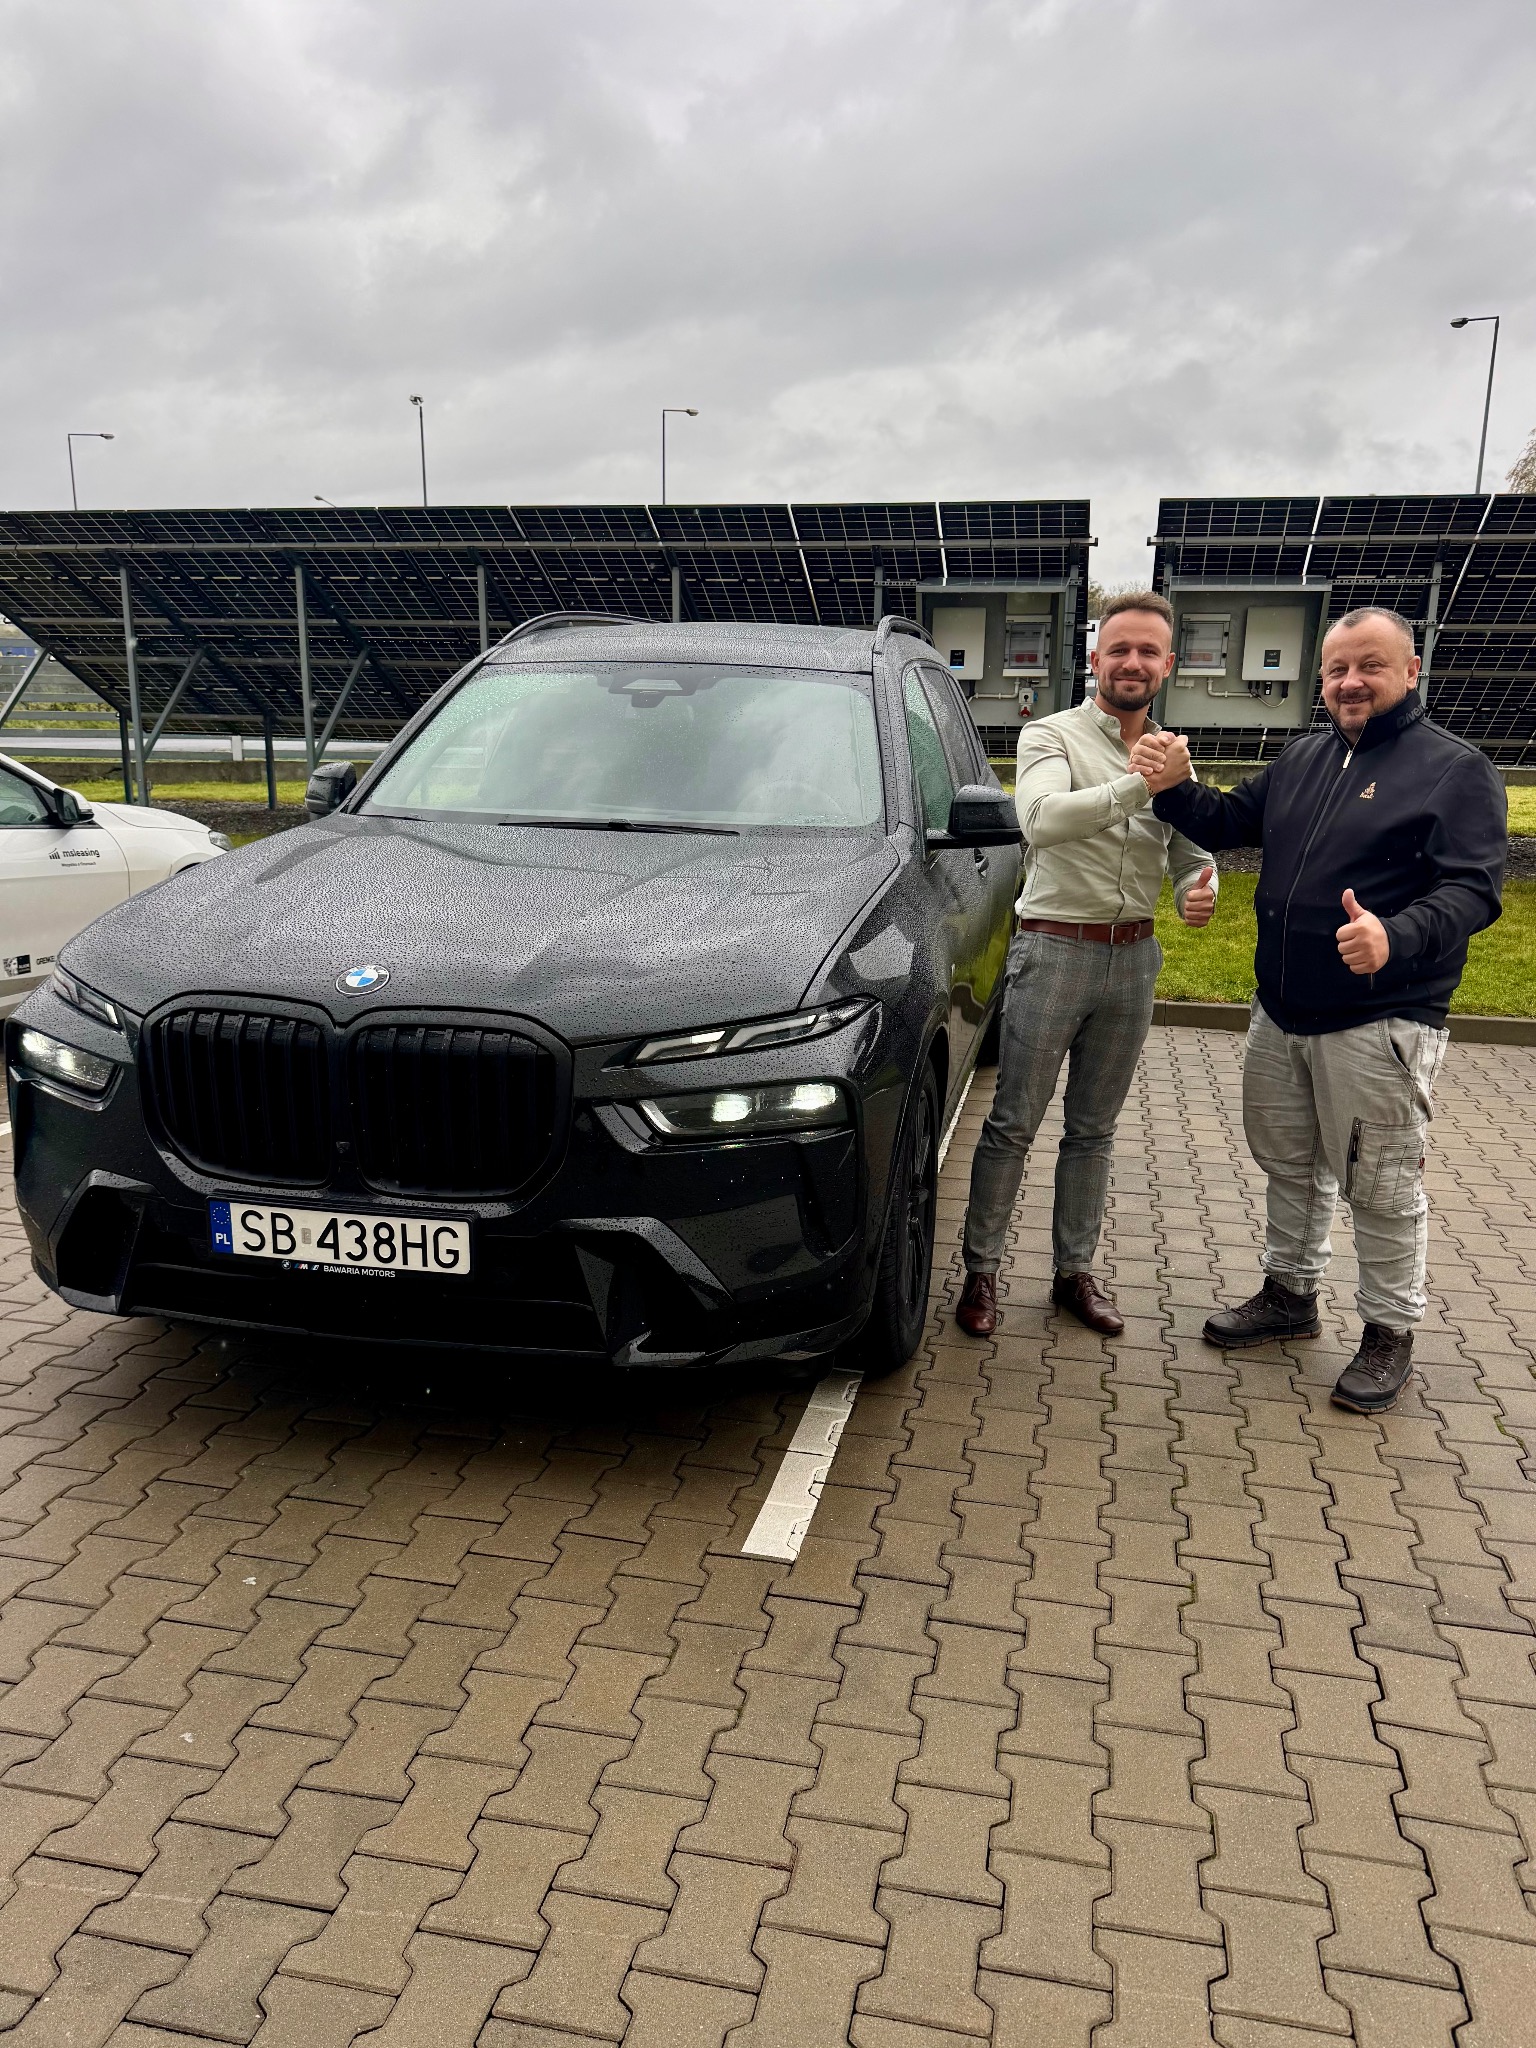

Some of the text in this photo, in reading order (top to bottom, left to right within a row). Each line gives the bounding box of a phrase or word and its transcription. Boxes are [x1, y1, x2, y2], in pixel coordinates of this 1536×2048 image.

[62, 848, 100, 858] msleasing
[215, 1232, 231, 1245] PL
[240, 1209, 460, 1269] SB 438HG
[323, 1265, 360, 1275] BAWARIA
[361, 1268, 396, 1278] MOTORS
